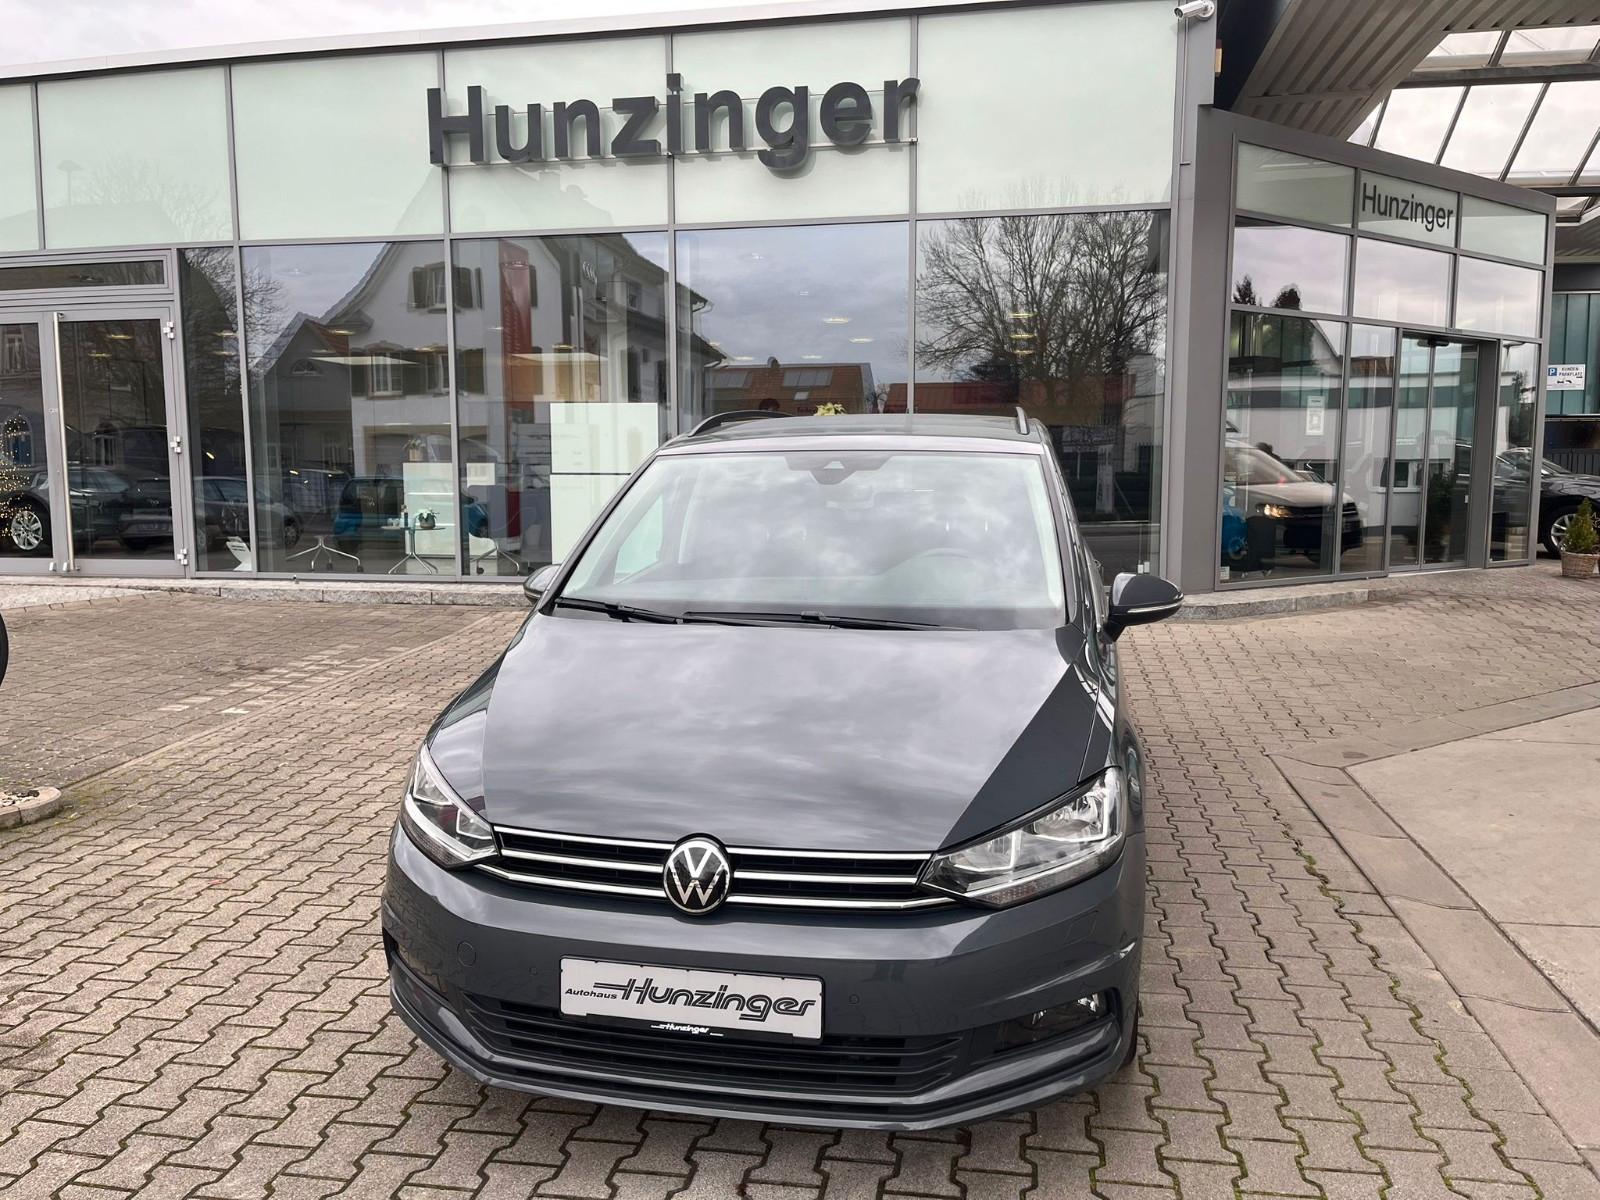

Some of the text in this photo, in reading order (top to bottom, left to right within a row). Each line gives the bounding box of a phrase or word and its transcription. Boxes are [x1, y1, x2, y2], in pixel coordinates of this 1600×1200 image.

[427, 73, 920, 169] Hunzinger
[1362, 182, 1454, 232] Hunzinger
[564, 978, 816, 1022] Autohaus Hunzinger
[659, 1023, 709, 1034] Hunzinger
